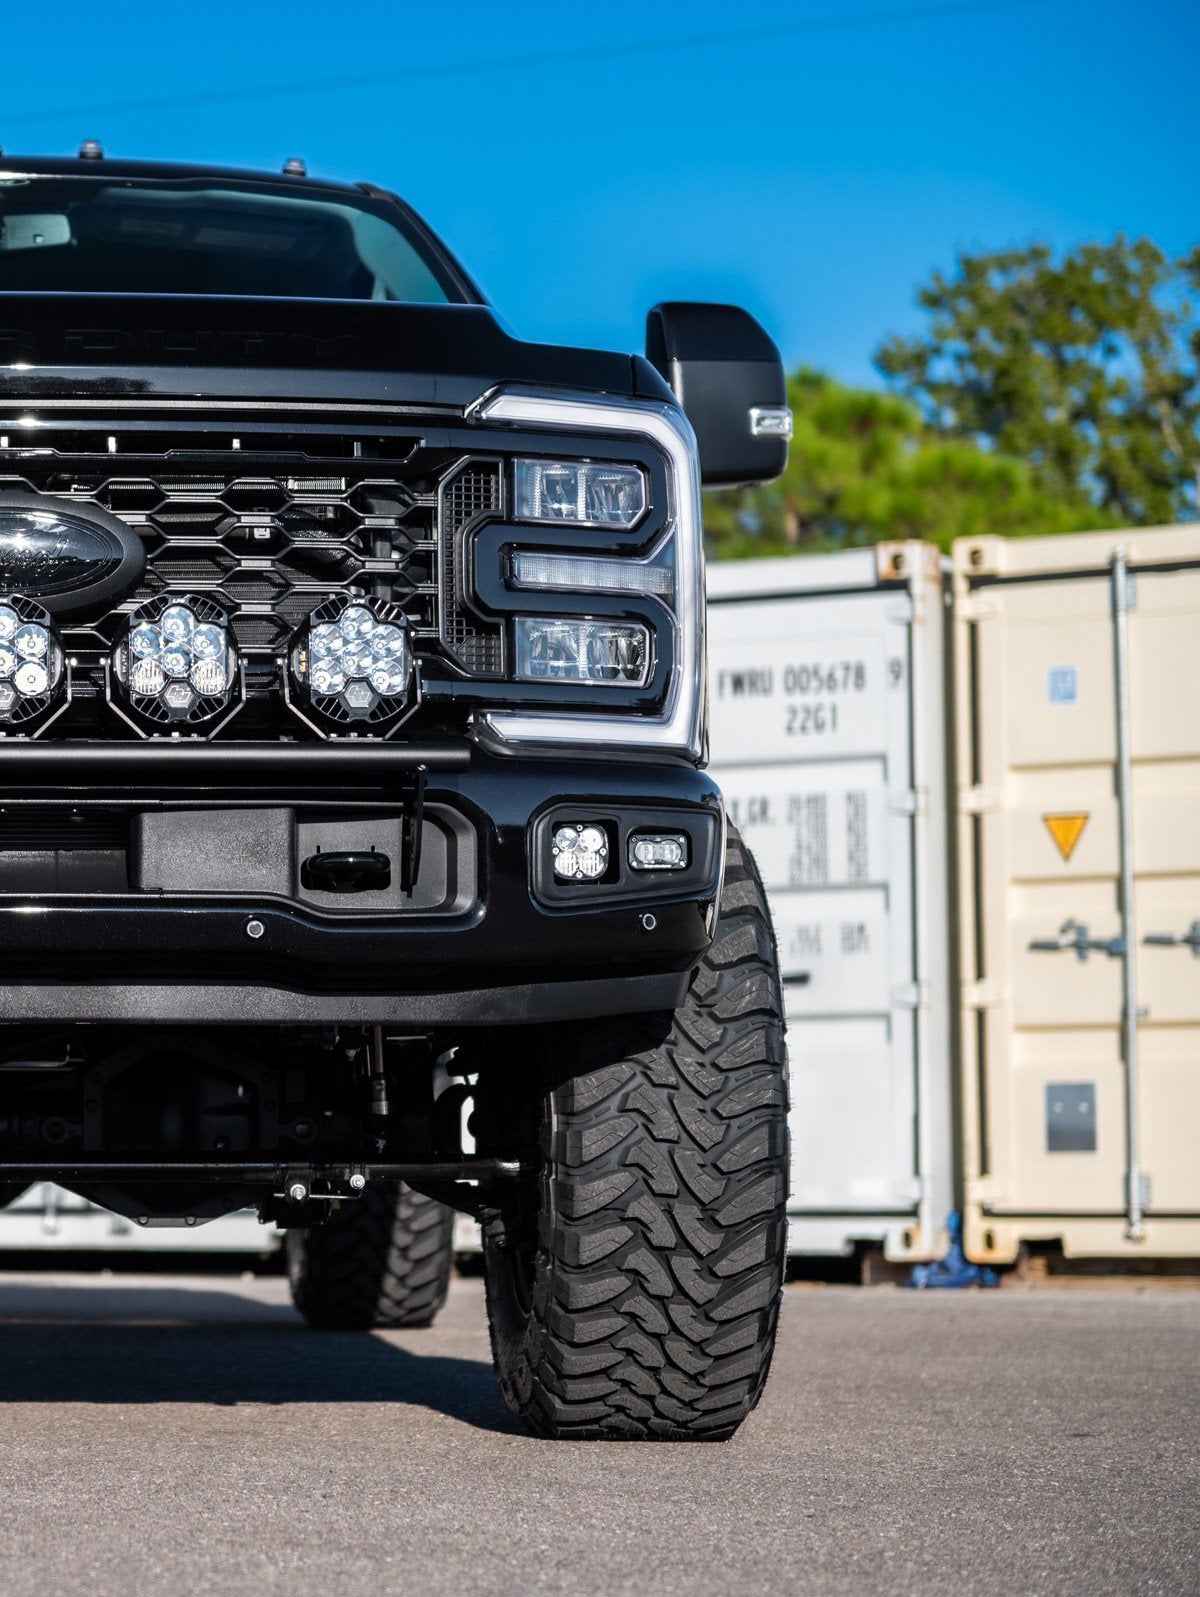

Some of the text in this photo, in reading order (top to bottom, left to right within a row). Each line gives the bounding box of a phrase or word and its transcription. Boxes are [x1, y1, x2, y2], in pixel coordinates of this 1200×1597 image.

[63, 328, 357, 356] DUTY
[718, 667, 773, 698] FWRU
[783, 661, 867, 695] 005678
